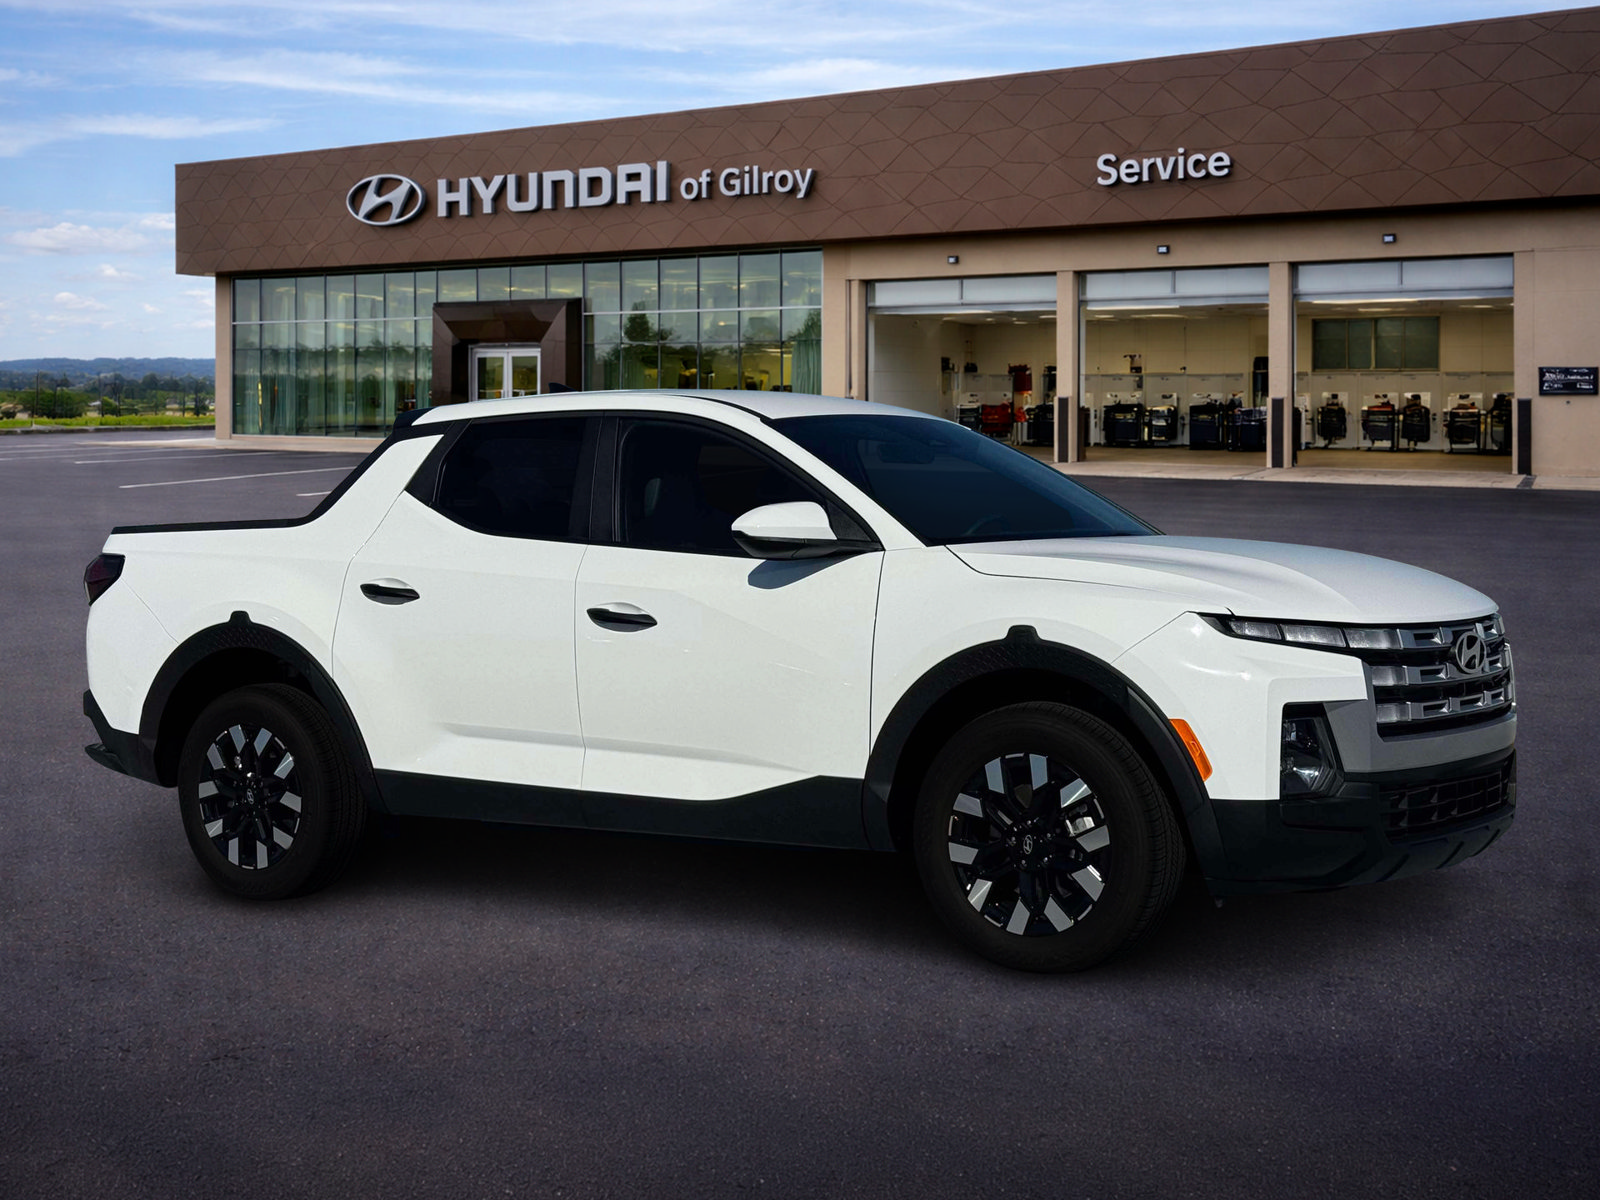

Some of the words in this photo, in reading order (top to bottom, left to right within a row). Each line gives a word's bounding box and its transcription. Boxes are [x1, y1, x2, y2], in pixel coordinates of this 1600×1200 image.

[437, 160, 669, 217] HYUNDAI
[680, 168, 711, 200] of
[718, 164, 813, 199] Gilroy
[1096, 147, 1231, 186] Service
